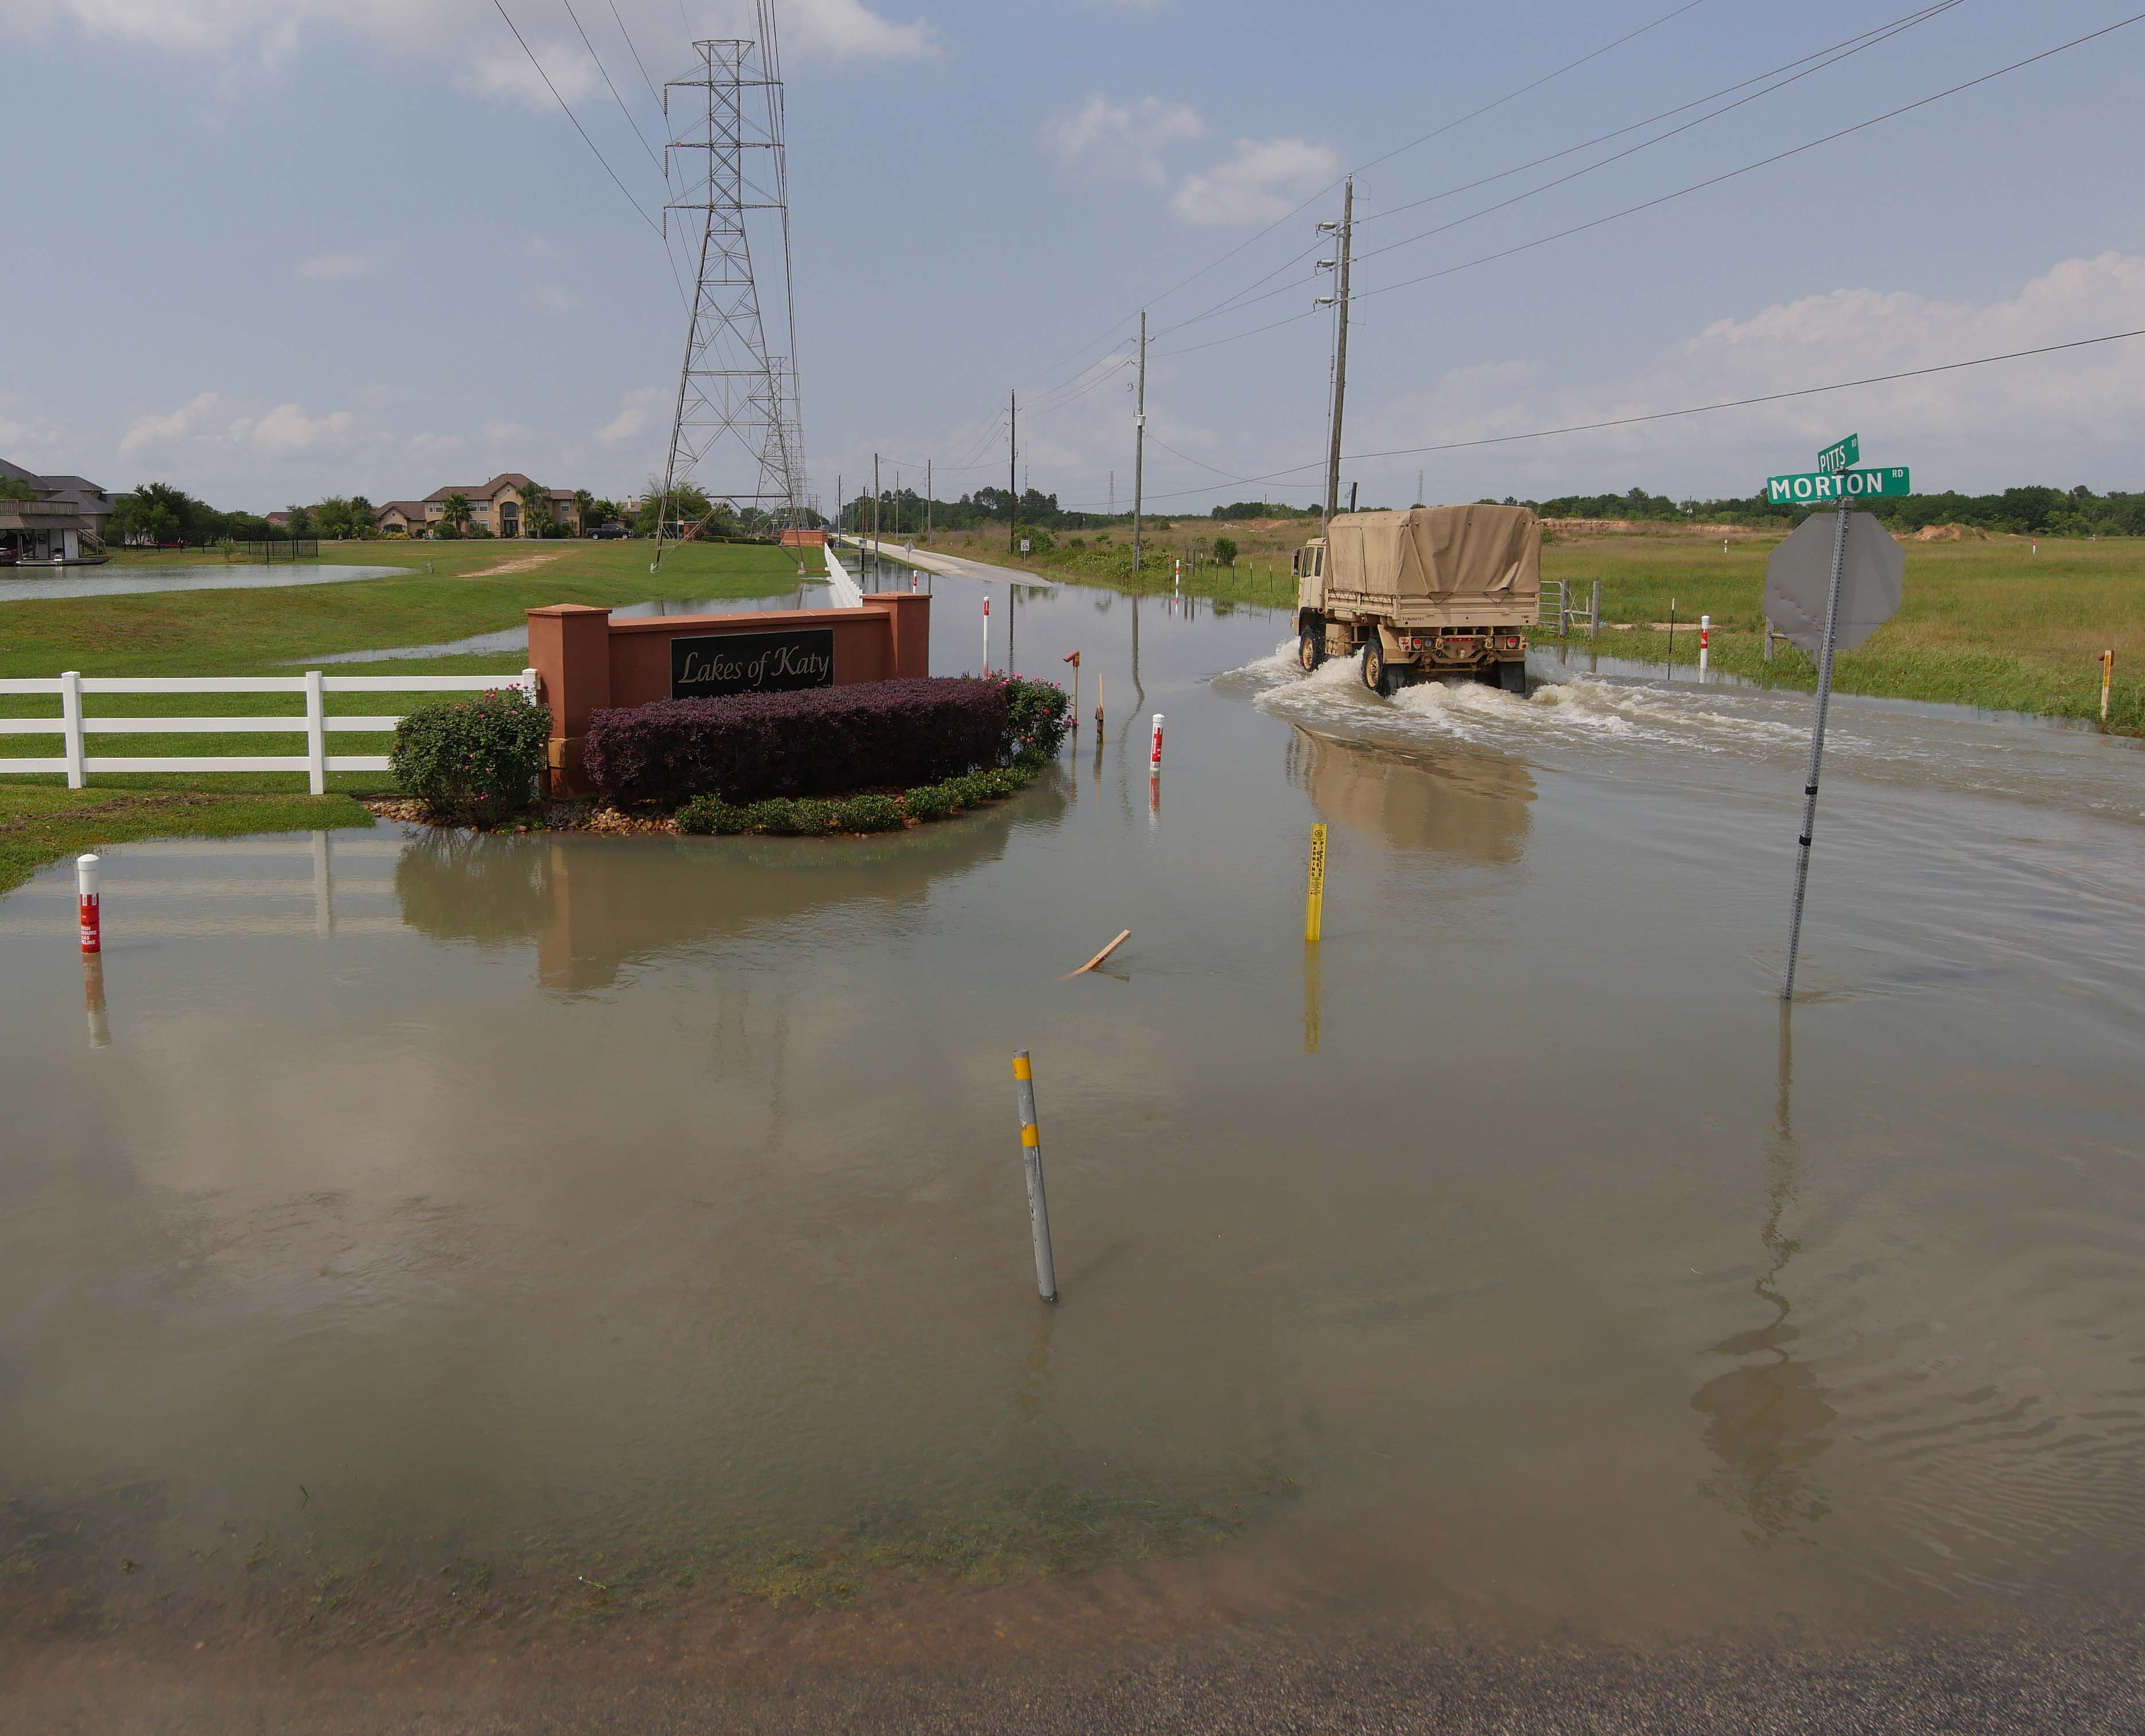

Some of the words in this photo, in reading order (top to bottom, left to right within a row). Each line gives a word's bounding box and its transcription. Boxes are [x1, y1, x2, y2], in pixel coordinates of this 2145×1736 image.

[1820, 445, 1845, 473] PITTS
[1771, 472, 1883, 499] MORTON
[1892, 469, 1903, 478] RD
[677, 652, 743, 683] Lakes
[748, 650, 771, 687] of
[771, 645, 829, 681] Katy
